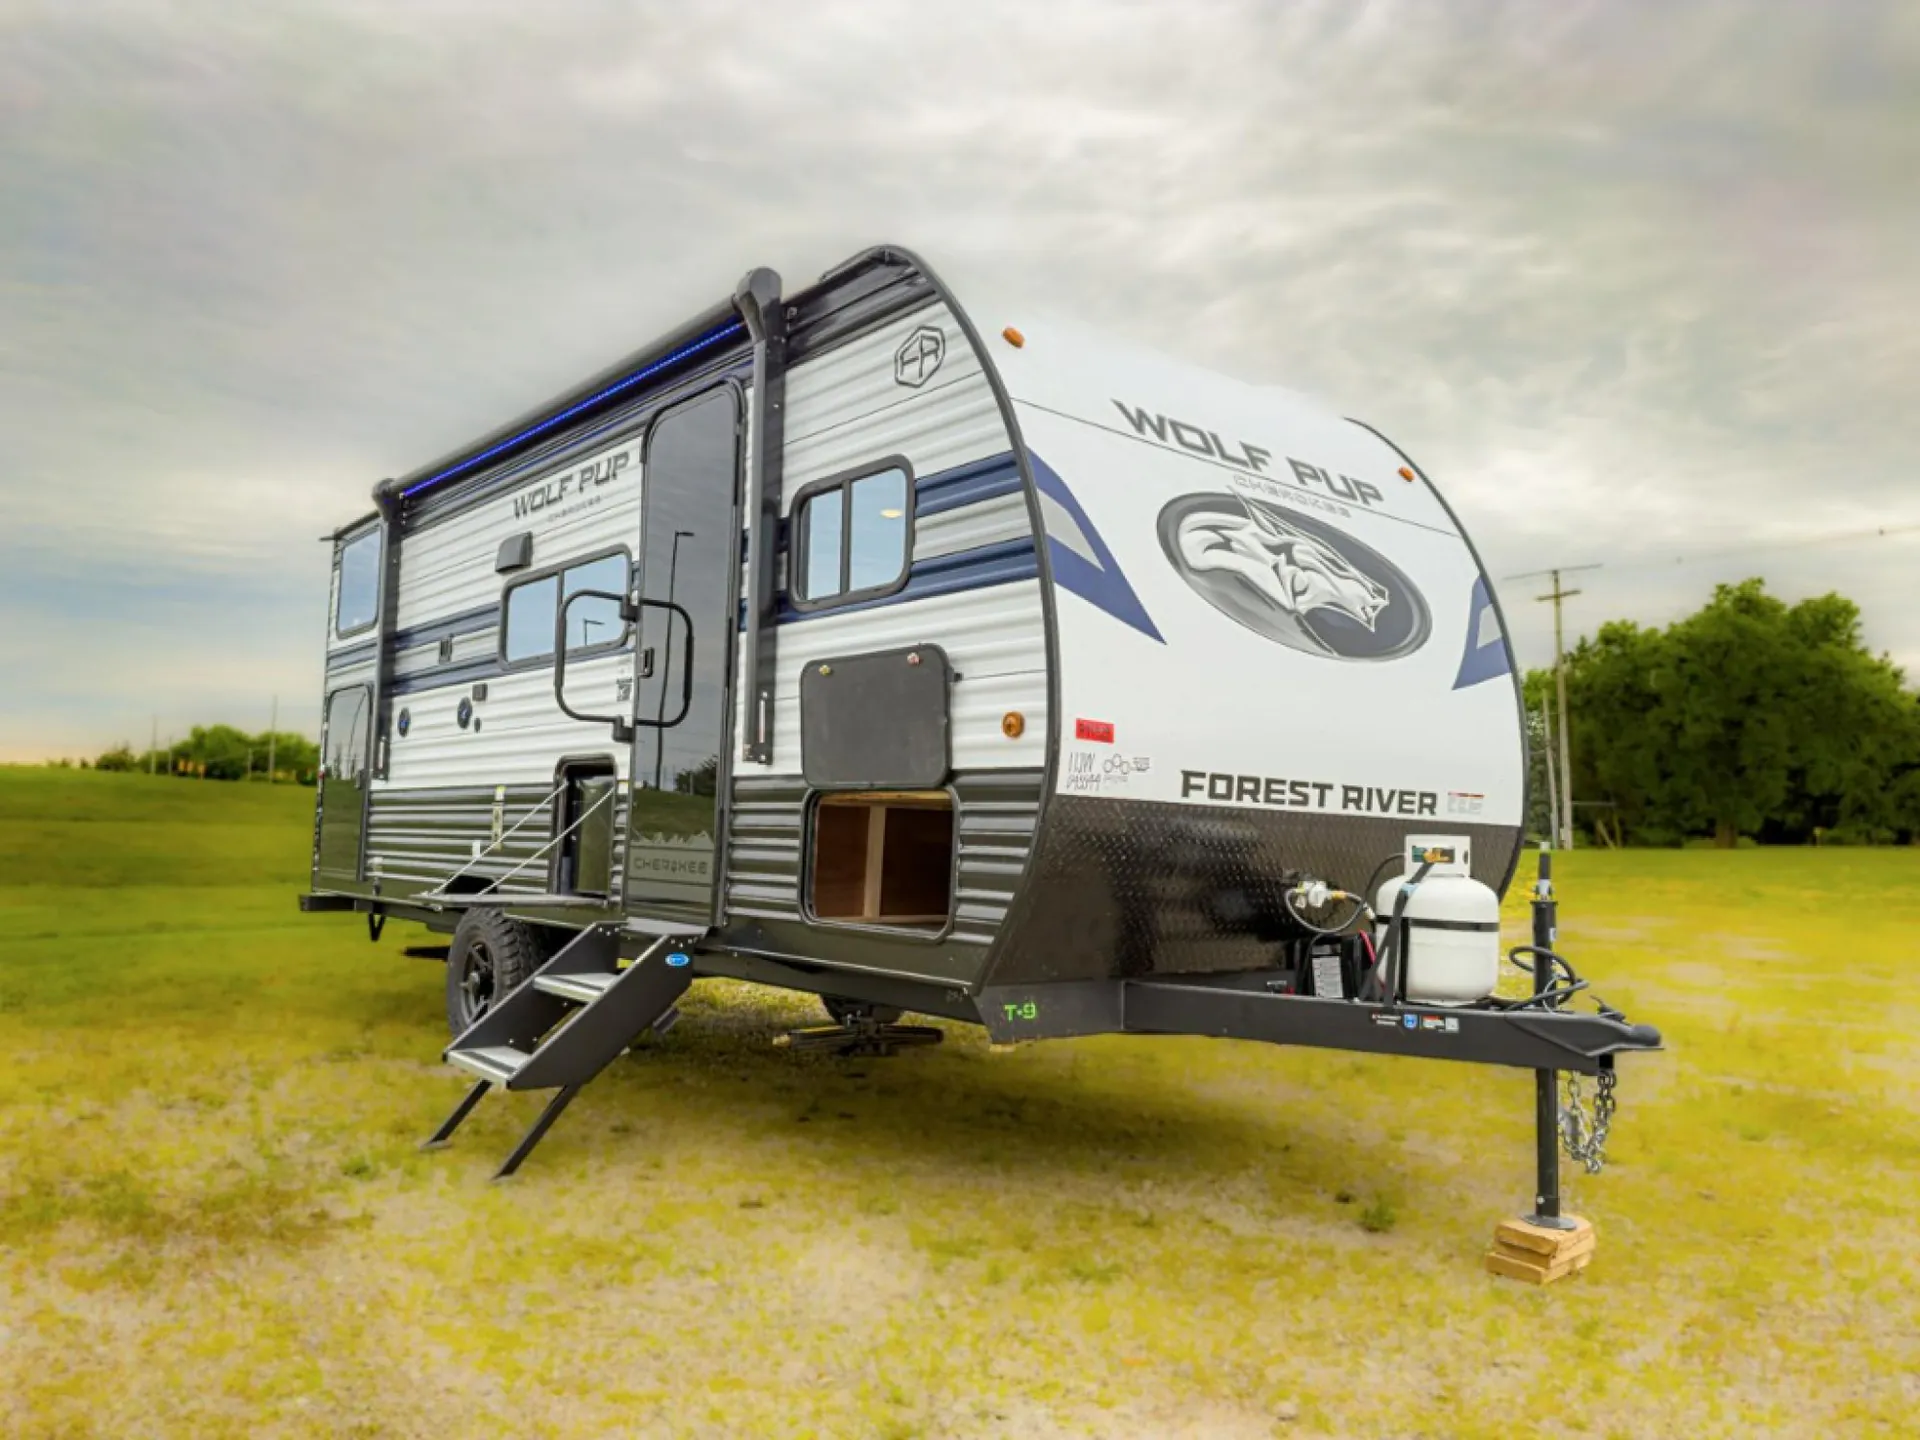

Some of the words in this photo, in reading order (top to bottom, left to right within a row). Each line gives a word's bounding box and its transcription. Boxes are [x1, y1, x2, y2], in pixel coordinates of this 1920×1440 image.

[512, 474, 574, 520] WOLF
[578, 451, 630, 493] PUP
[1110, 397, 1271, 472] WOLF
[1287, 457, 1384, 505] PUP
[1181, 769, 1335, 809] FOREST
[1341, 784, 1438, 816] RIVER
